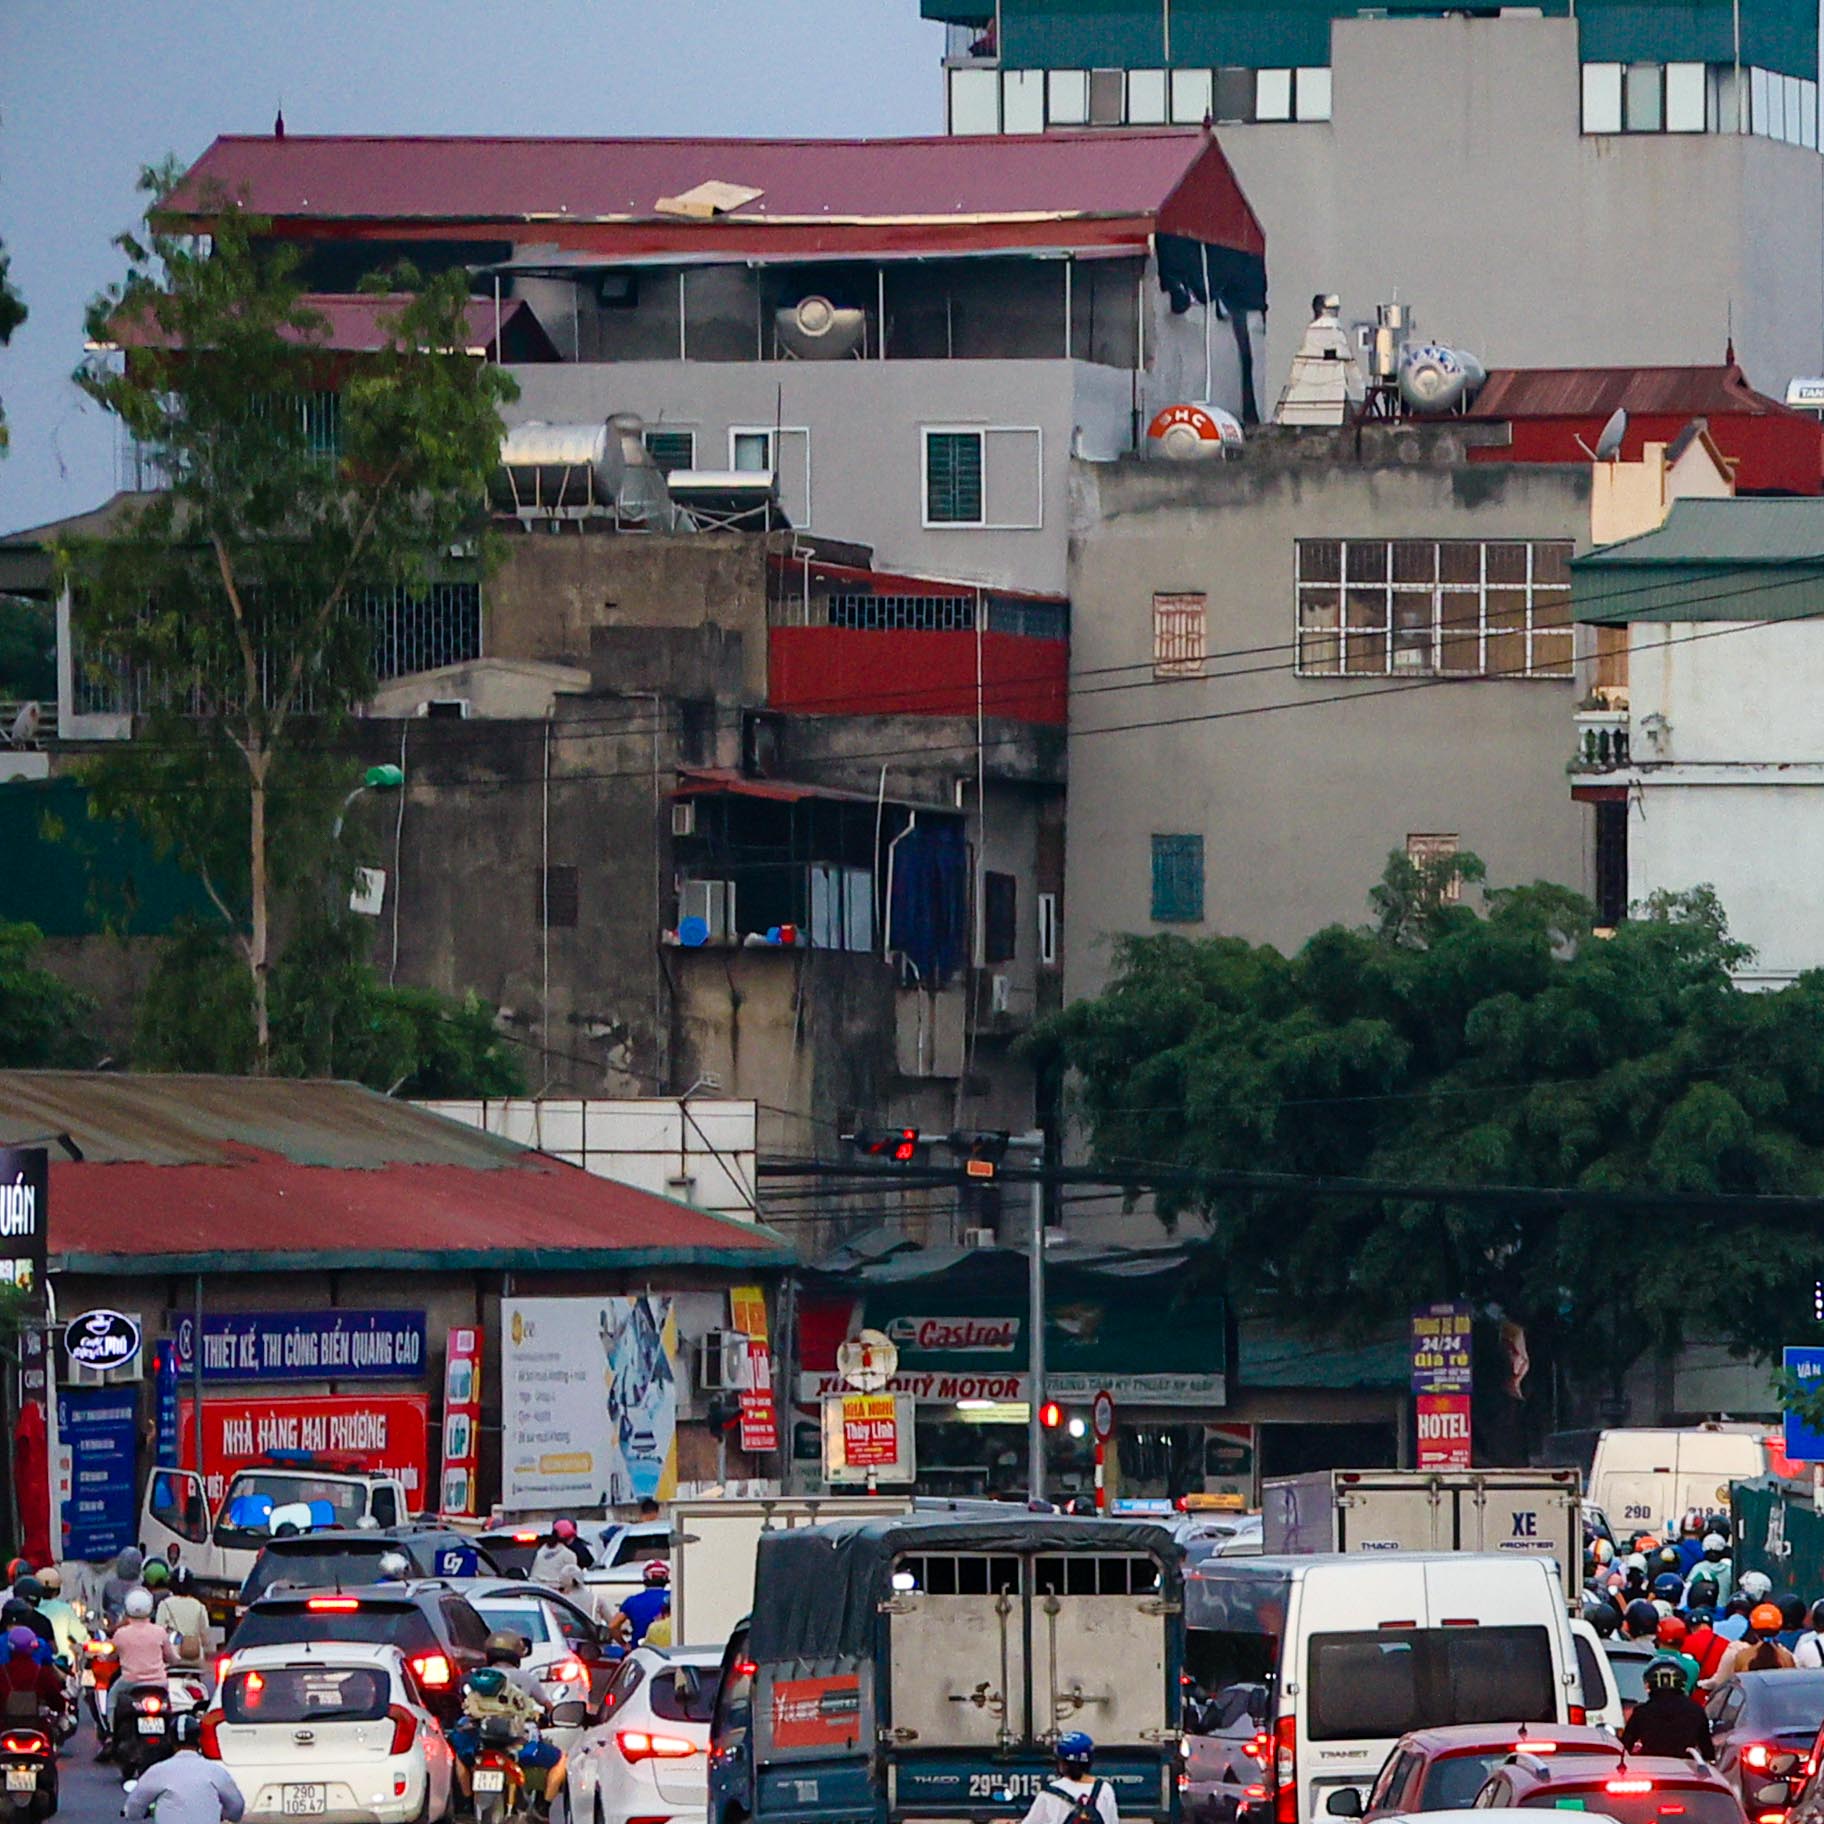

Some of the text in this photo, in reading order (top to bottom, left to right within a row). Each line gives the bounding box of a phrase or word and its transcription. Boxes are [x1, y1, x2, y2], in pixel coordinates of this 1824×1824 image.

[262, 1333, 282, 1367] THI
[285, 1326, 319, 1366] CÔNG
[918, 1319, 1017, 1350] Castrol
[938, 1377, 1020, 1399] MOTOR
[223, 1412, 253, 1455] NHÀ
[258, 1410, 297, 1451] HÀNG
[301, 1416, 327, 1450] MAI
[1417, 1413, 1469, 1439] HOTEL
[1511, 1512, 1537, 1536] XE
